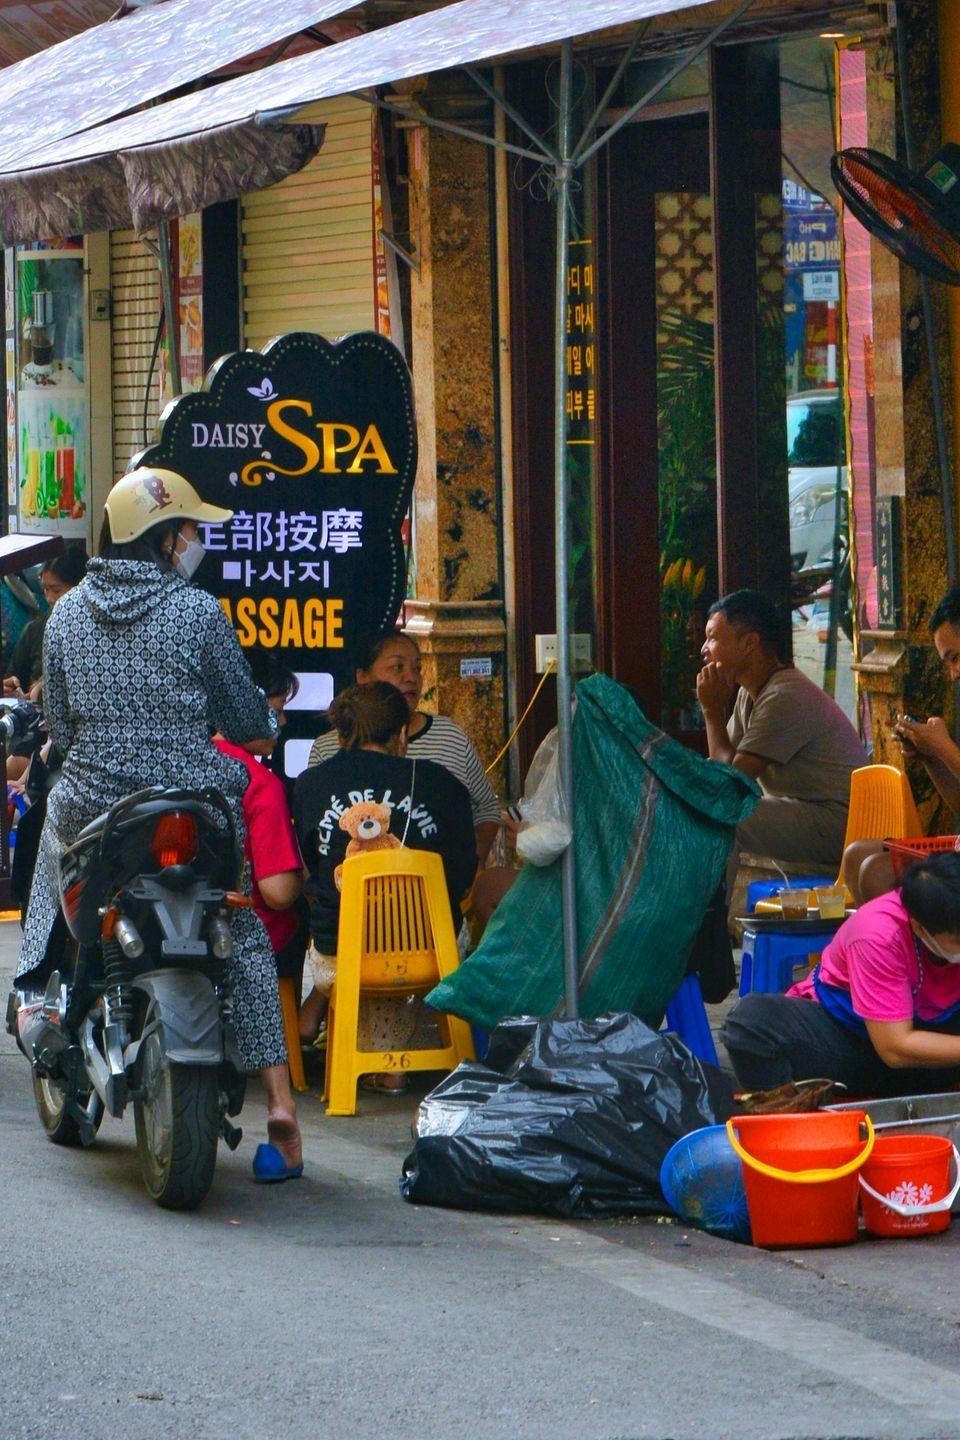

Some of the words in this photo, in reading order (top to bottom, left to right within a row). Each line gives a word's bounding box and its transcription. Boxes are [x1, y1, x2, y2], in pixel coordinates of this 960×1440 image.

[191, 422, 266, 448] DAISY
[241, 398, 398, 487] SPA
[222, 559, 330, 588] 마사지
[348, 788, 374, 806] DE
[382, 789, 412, 813] LA
[410, 803, 438, 839] VIE
